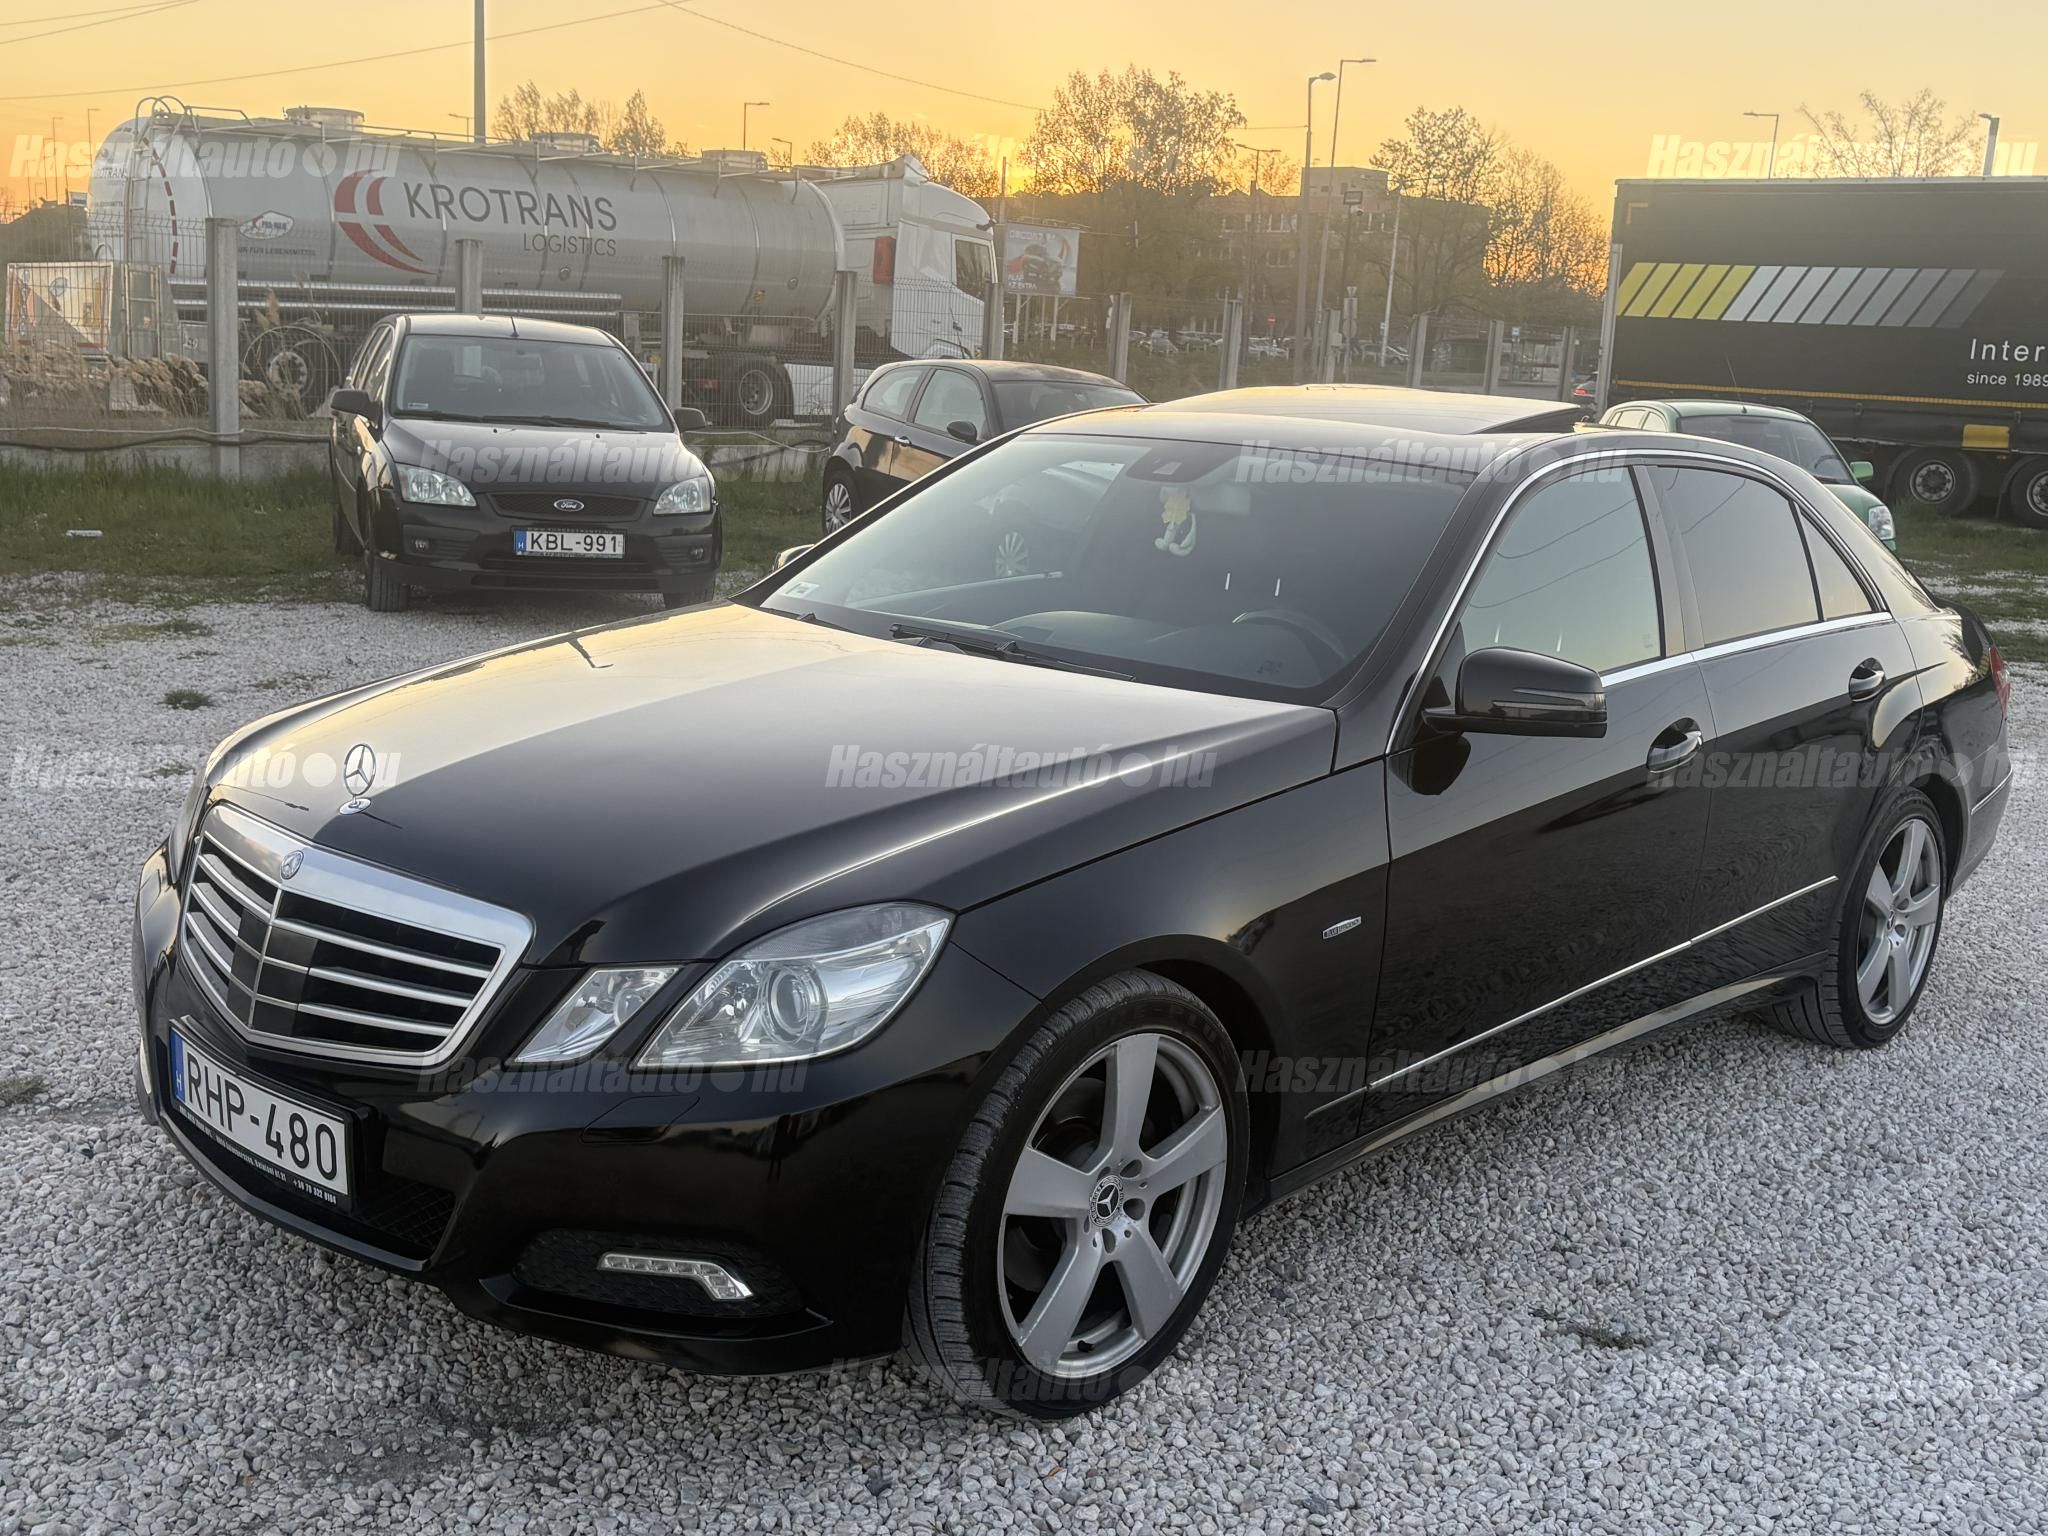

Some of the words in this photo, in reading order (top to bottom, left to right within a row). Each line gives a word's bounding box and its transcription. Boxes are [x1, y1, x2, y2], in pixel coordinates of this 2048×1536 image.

[403, 181, 617, 231] KROTRANS
[523, 232, 617, 257] LOGISTICS
[1970, 338, 2046, 362] Inter
[1967, 371, 2007, 385] since
[2014, 372, 2048, 387] 1989
[530, 532, 617, 553] KBL-991
[186, 1051, 338, 1181] RHP-480
